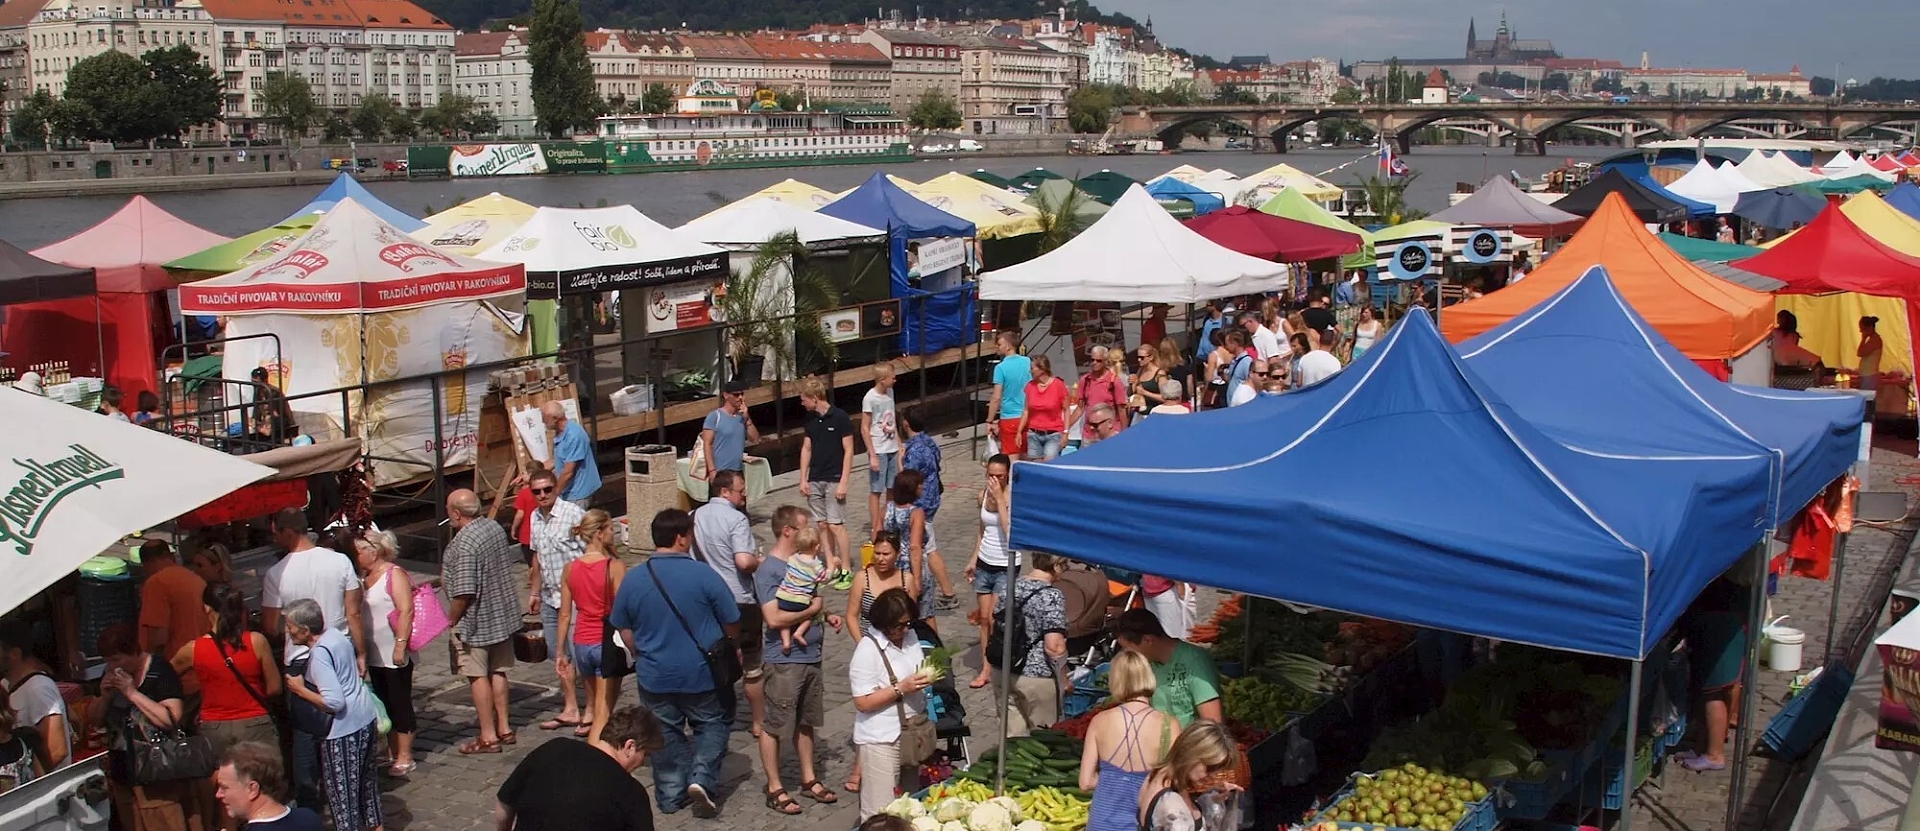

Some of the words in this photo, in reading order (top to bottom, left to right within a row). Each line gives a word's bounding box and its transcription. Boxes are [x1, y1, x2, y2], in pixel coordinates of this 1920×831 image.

[547, 149, 585, 158] Originalita.
[573, 221, 605, 243] fair
[591, 239, 618, 251] bio
[609, 267, 642, 281] radost!
[684, 265, 690, 273] a
[378, 284, 418, 300] TRADIČNÍ
[421, 281, 456, 294] PIVOVAR
[457, 280, 464, 290] V
[465, 274, 511, 289] RAKOVNÍKU
[197, 291, 238, 304] TRADIČNÍ
[240, 291, 277, 303] PIVOVAR
[279, 291, 286, 301] V
[288, 290, 341, 303] RAKOVNÍKU
[12, 443, 114, 489] Urquell
